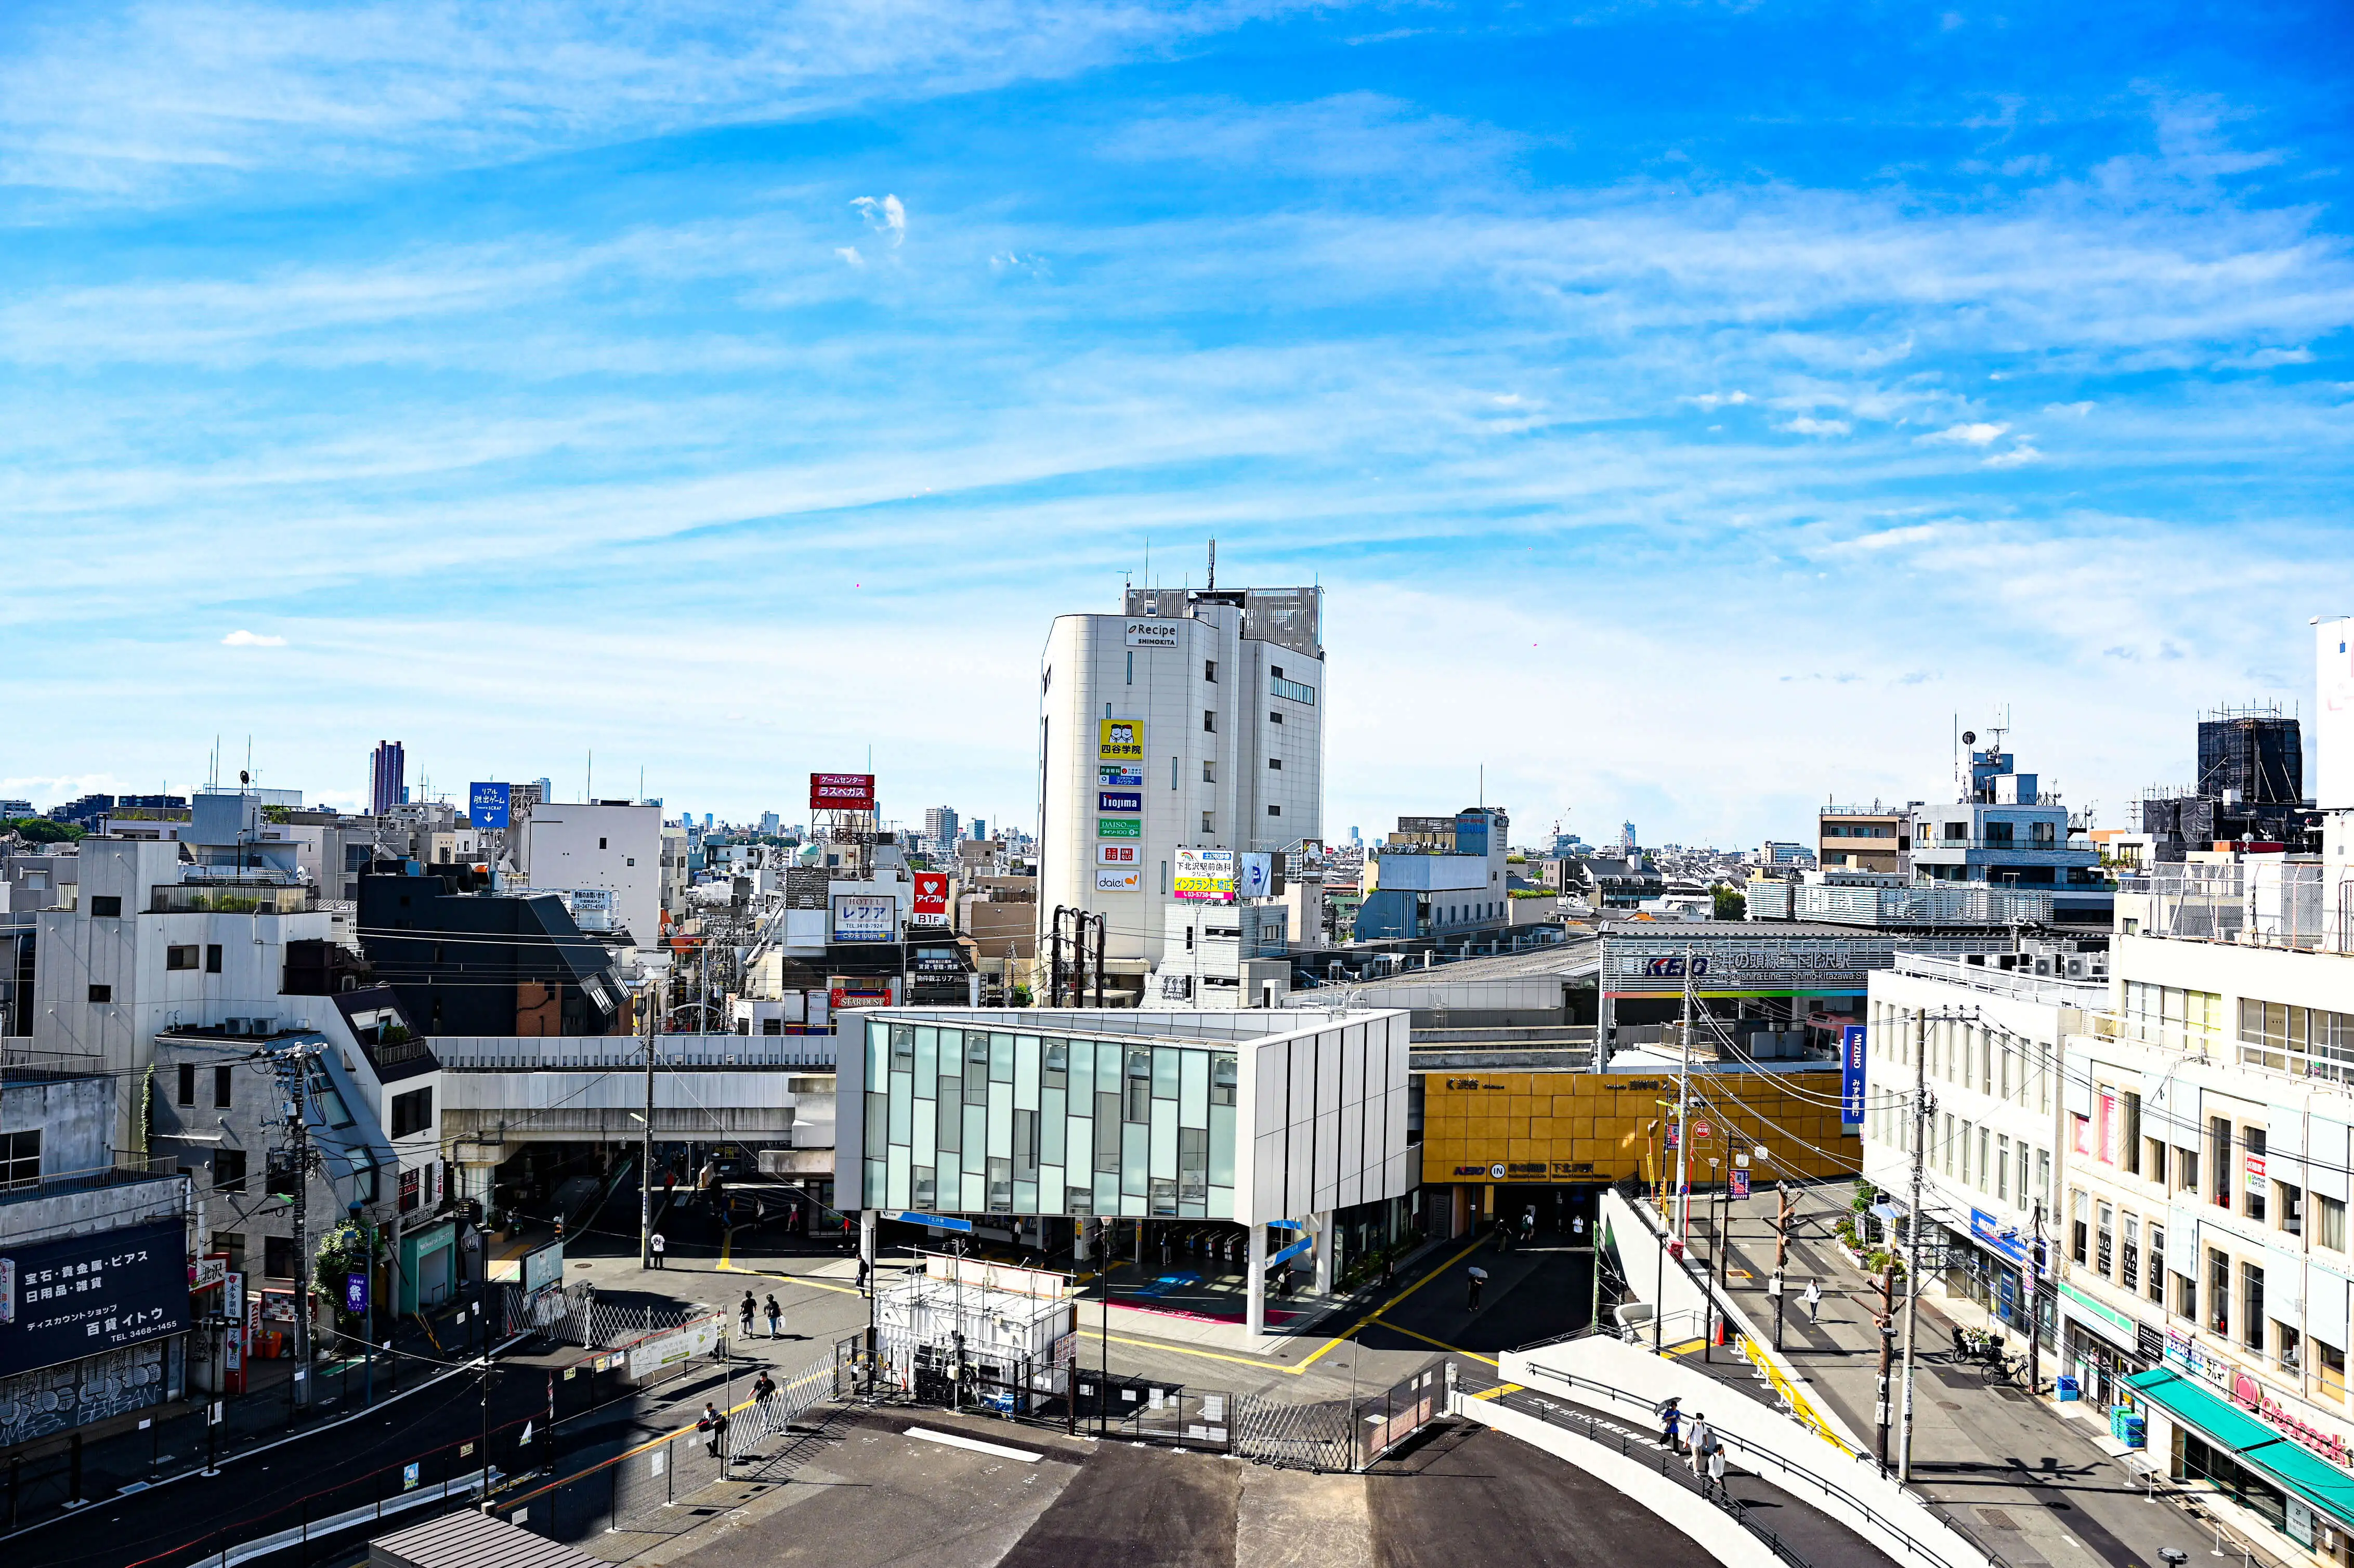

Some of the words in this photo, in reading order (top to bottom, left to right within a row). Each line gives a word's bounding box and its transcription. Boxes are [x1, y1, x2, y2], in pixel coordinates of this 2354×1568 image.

[1139, 624, 1175, 636] Recipe
[1102, 744, 1141, 754] 四谷学院
[820, 787, 865, 796] ラスベガス
[474, 795, 505, 804] 脱出ゲーム
[1458, 824, 1486, 834] LEHUA
[1384, 843, 1417, 854] ホテル
[1177, 862, 1231, 871] 下北沢駅前歯科
[1099, 878, 1124, 887] daiei
[917, 895, 944, 903] アイフル
[843, 907, 886, 919] レフア
[919, 914, 939, 923] B1F
[1719, 952, 1779, 969] 井の頭線
[1794, 952, 1850, 969] 下北沢駅
[1719, 972, 1762, 981] Inokashira
[1764, 972, 1781, 981] Line
[907, 989, 911, 998] 入口
[1853, 1034, 1862, 1069] MIZUHO
[1852, 1079, 1860, 1117] みずほ銀行
[1454, 1166, 1486, 1175] KEIO
[1978, 1217, 2002, 1237] MIZUHO
[25, 1251, 148, 1286] 宝石・貴金属・ピアス
[26, 1277, 102, 1303] 日用品・雑貨
[27, 1304, 117, 1331] ディスカウントショップ
[86, 1308, 163, 1337] 百貨イトウ
[111, 1333, 127, 1342] TEL
[130, 1321, 177, 1338] 3468-1455
[2262, 1397, 2346, 1466] Peacock
